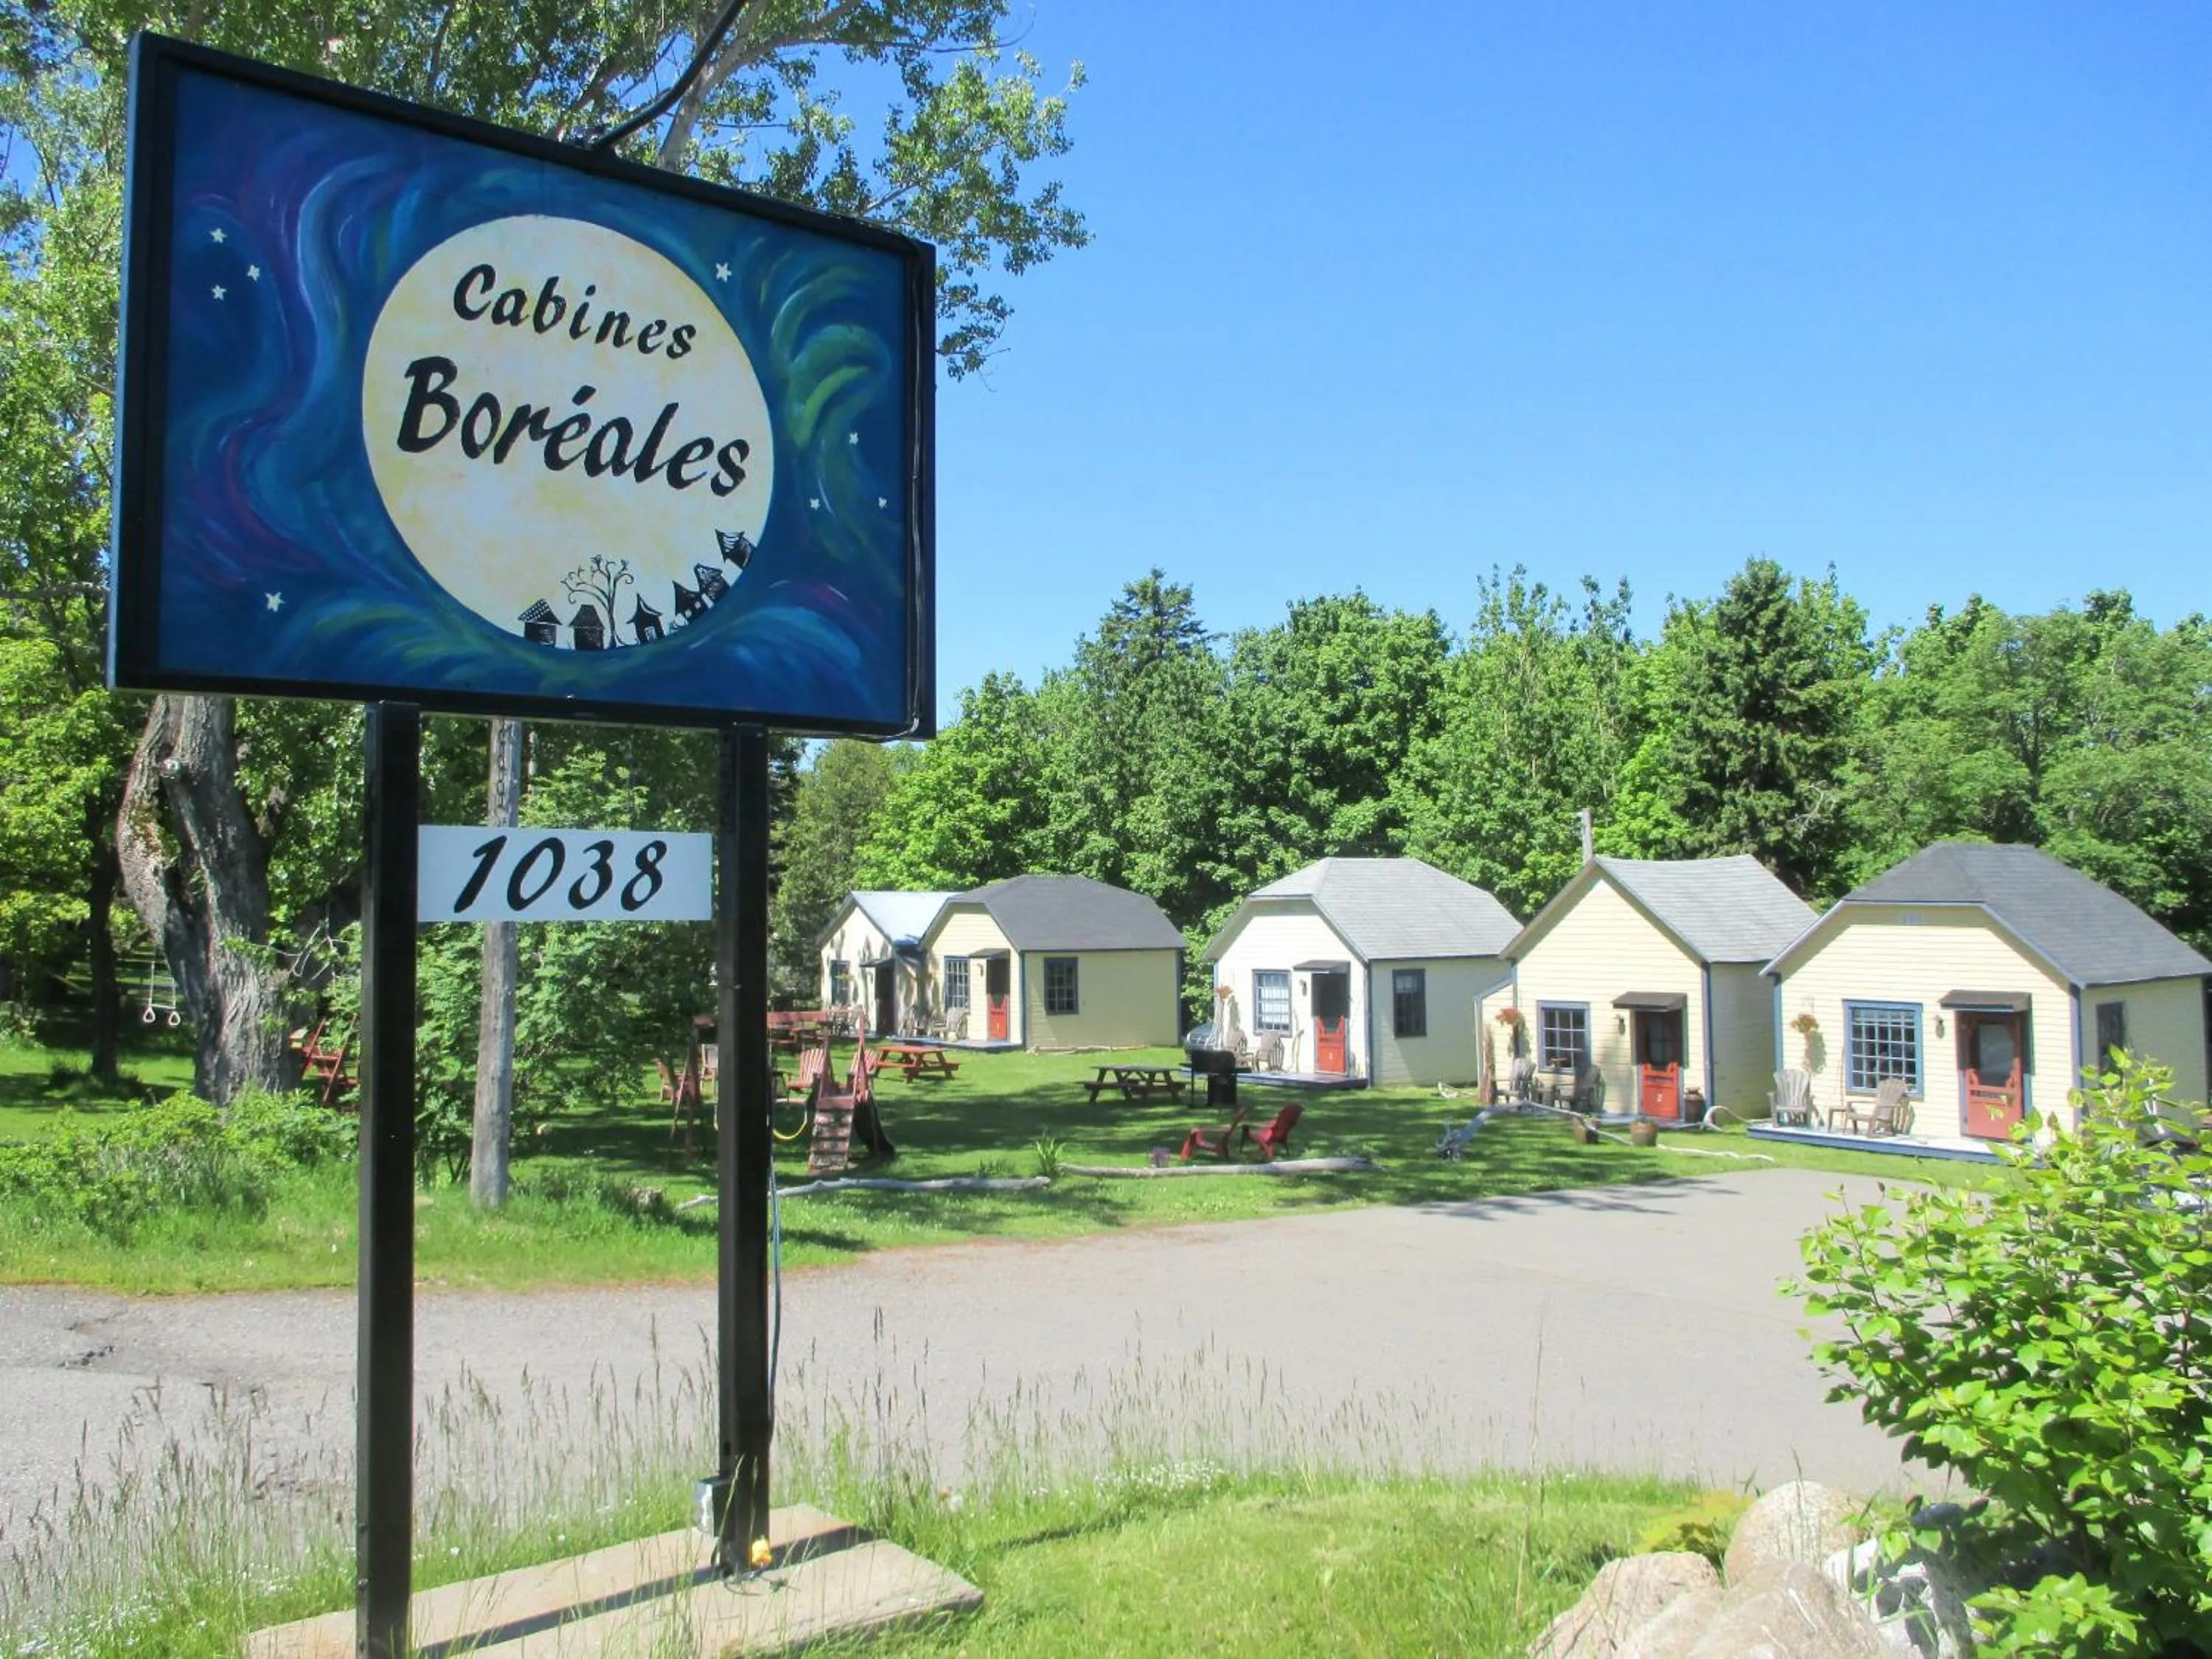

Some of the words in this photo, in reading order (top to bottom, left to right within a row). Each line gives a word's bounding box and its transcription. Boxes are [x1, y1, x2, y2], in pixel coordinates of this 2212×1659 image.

[453, 264, 697, 360] Cabines
[397, 355, 750, 498] Boréales
[453, 835, 667, 914] 1038
